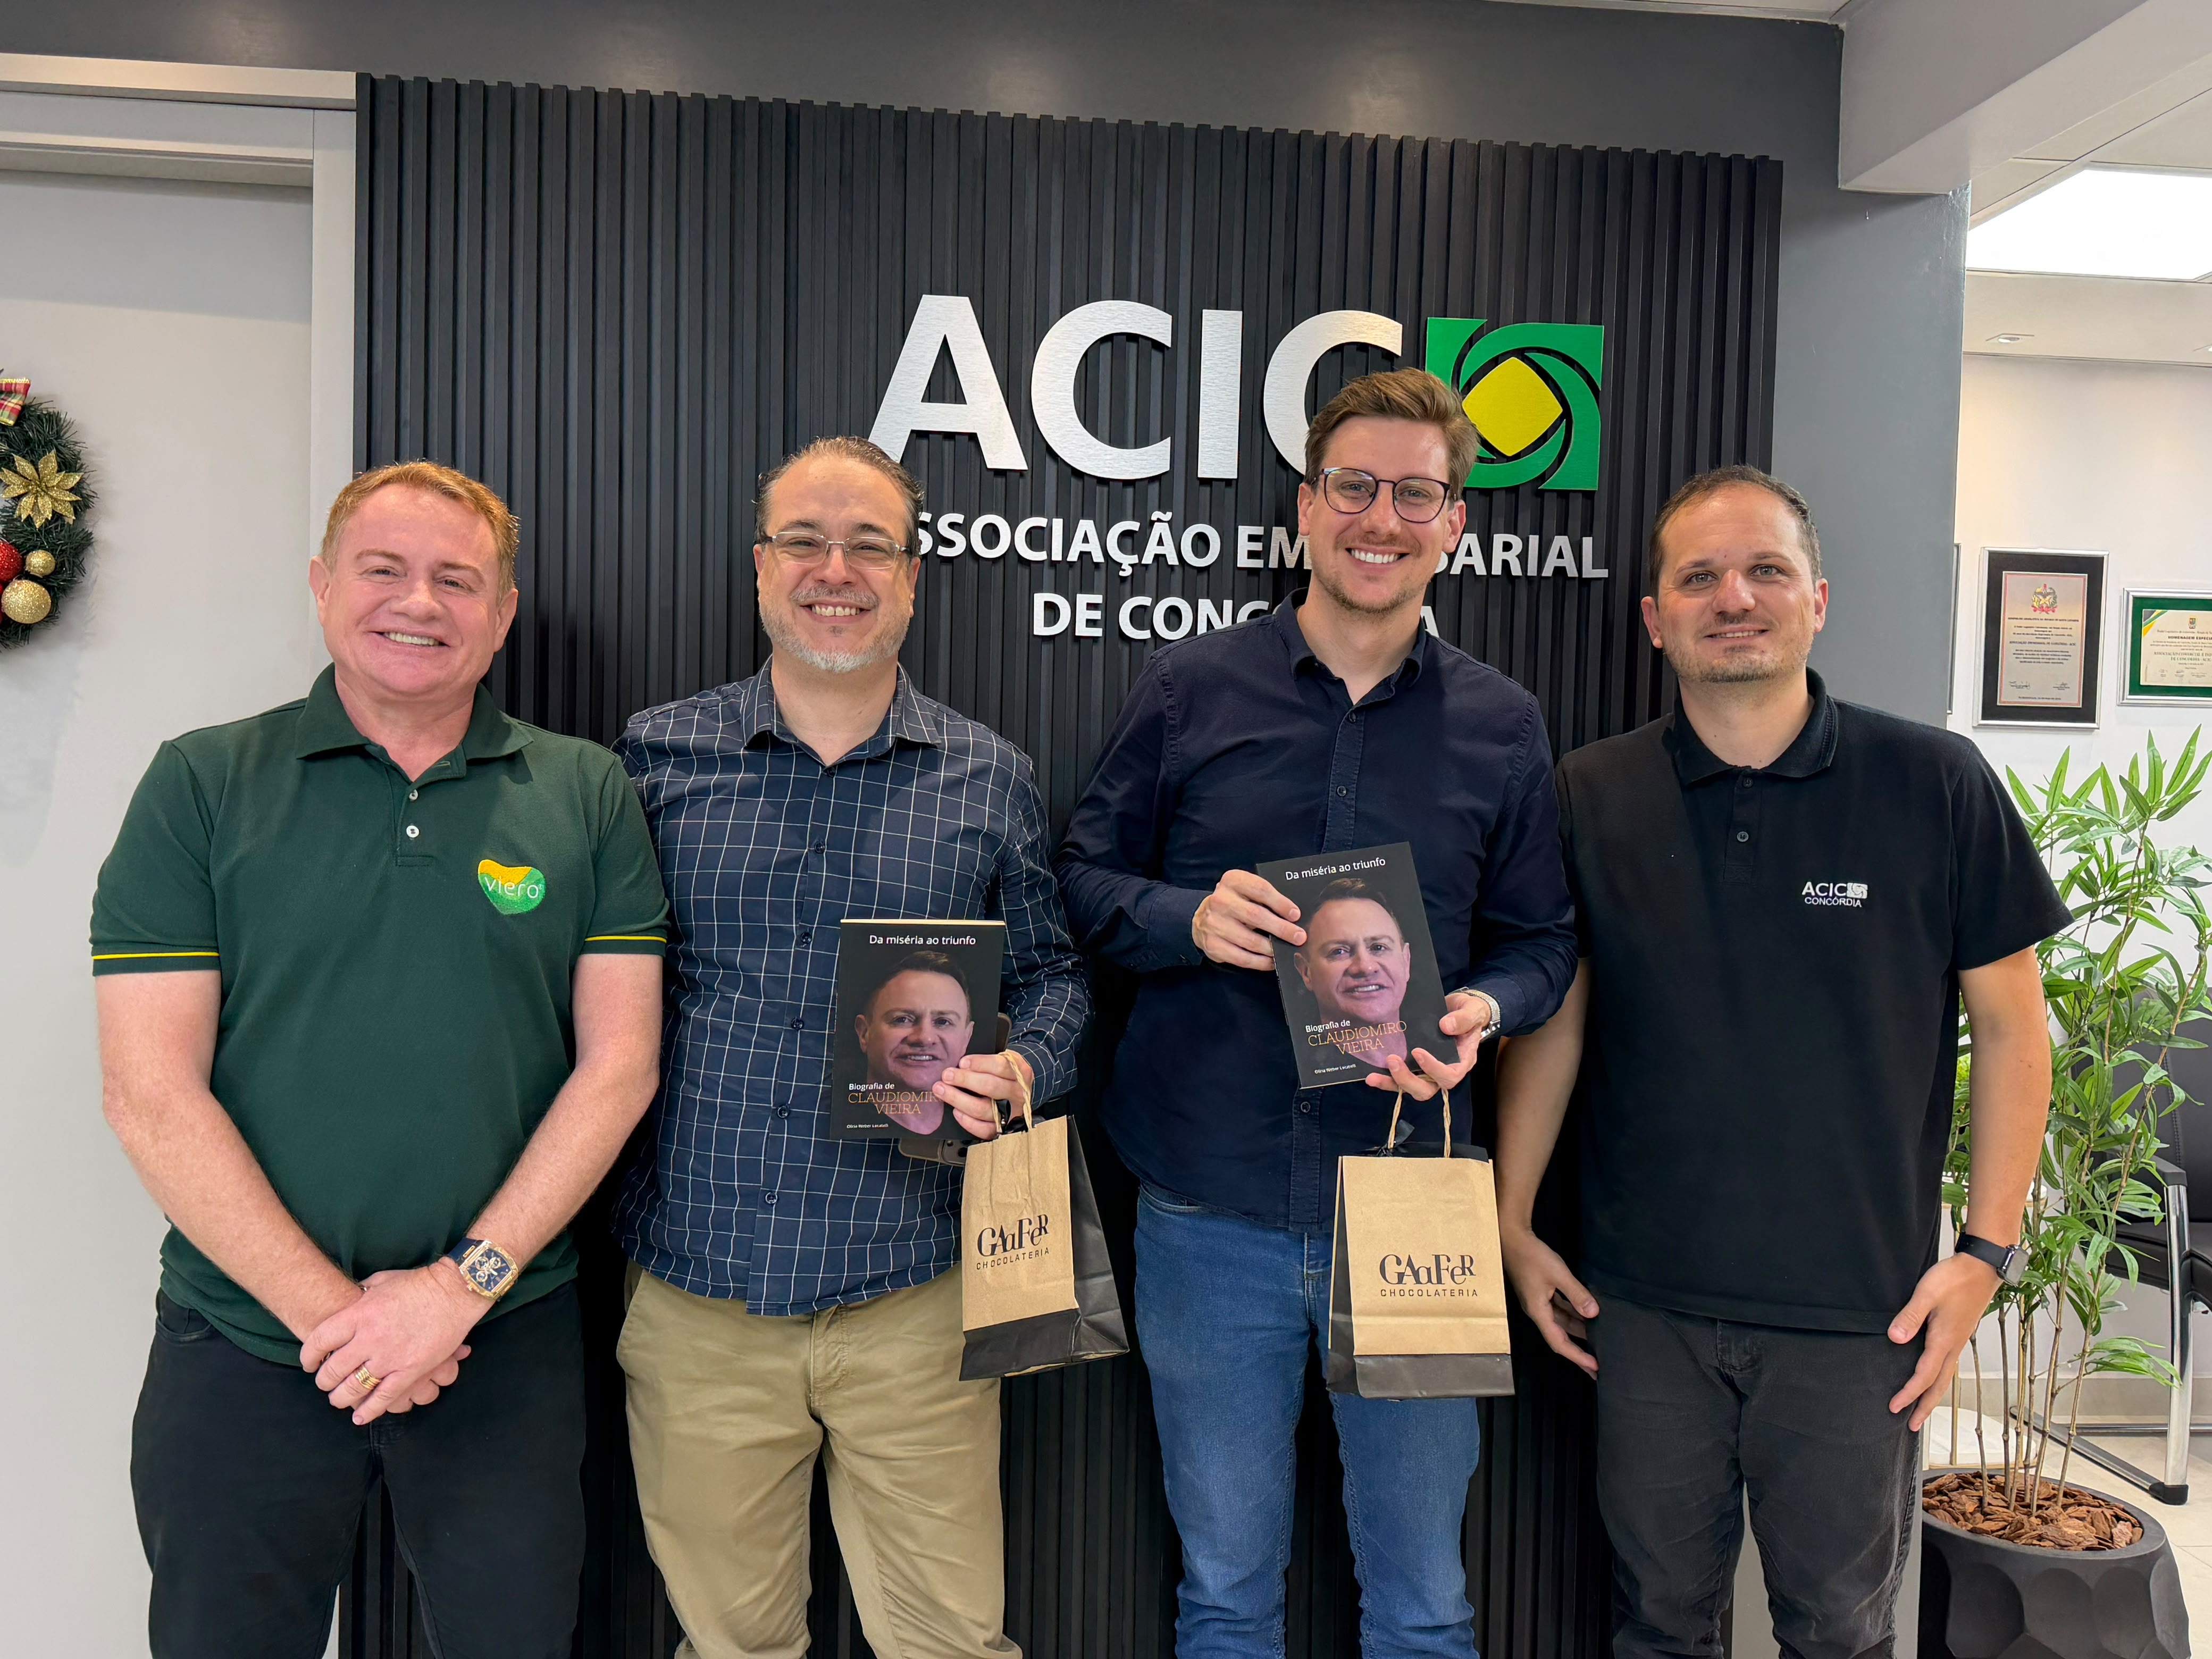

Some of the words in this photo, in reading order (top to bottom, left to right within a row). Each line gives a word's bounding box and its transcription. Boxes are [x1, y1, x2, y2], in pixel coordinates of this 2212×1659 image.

[868, 294, 1403, 480] ACIC
[918, 510, 1221, 577] SSOCIAÇÃO
[1033, 592, 1103, 637] DE
[1285, 872, 1300, 881] Da
[1302, 865, 1337, 878] miséria
[1339, 864, 1351, 873] ao
[1353, 857, 1386, 870] triunfo
[1802, 881, 1847, 897] ACIC
[1804, 896, 1862, 908] CONCÓRDIA
[869, 935, 883, 944] Da
[886, 935, 924, 945] miséria
[926, 936, 939, 945] ao
[941, 935, 976, 945] triunfo
[1305, 1020, 1339, 1033] Biografia
[1308, 1020, 1407, 1046] CLAUDIOMIRO
[1336, 1037, 1385, 1055] VIEIRA
[849, 1082, 883, 1091] Biografia
[848, 1091, 942, 1103] CLAUDIOMIR
[875, 1103, 921, 1115] VIEIRA
[976, 1247, 1050, 1270] CHOCOLATERIA
[1380, 1288, 1478, 1297] CHOCOLATERIA
